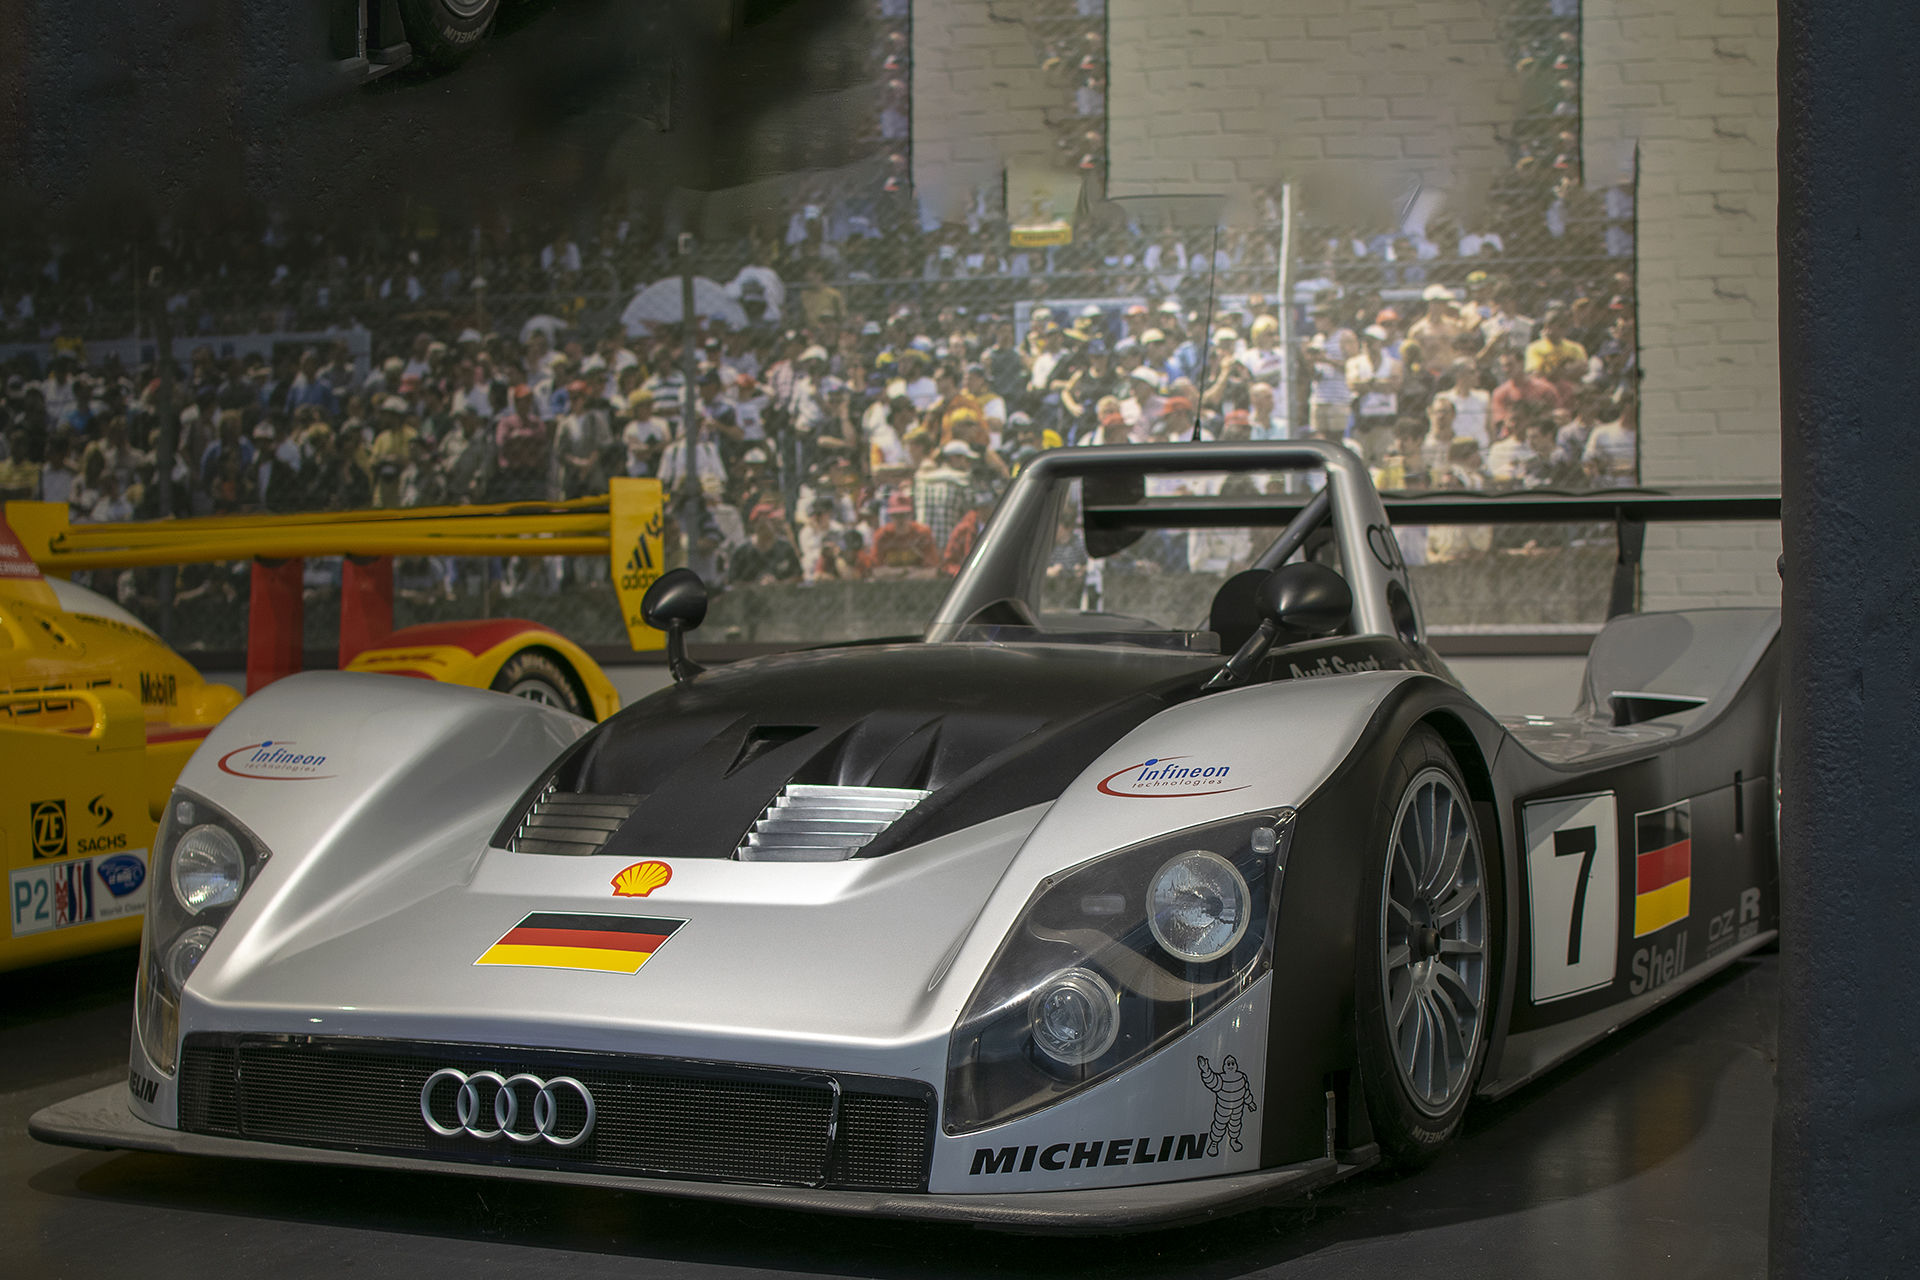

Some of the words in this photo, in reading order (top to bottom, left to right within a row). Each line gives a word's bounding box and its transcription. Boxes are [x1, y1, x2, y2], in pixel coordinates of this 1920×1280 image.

[244, 763, 317, 773] technologies
[250, 746, 327, 766] Infineon
[1131, 778, 1223, 789] technologies
[1137, 763, 1230, 782] Infineon
[36, 812, 63, 846] ZF
[77, 833, 127, 854] SACHS
[14, 878, 50, 924] P2
[1553, 825, 1597, 966] 7
[1630, 930, 1688, 995] Shell
[968, 1132, 1209, 1176] MICHELIN
